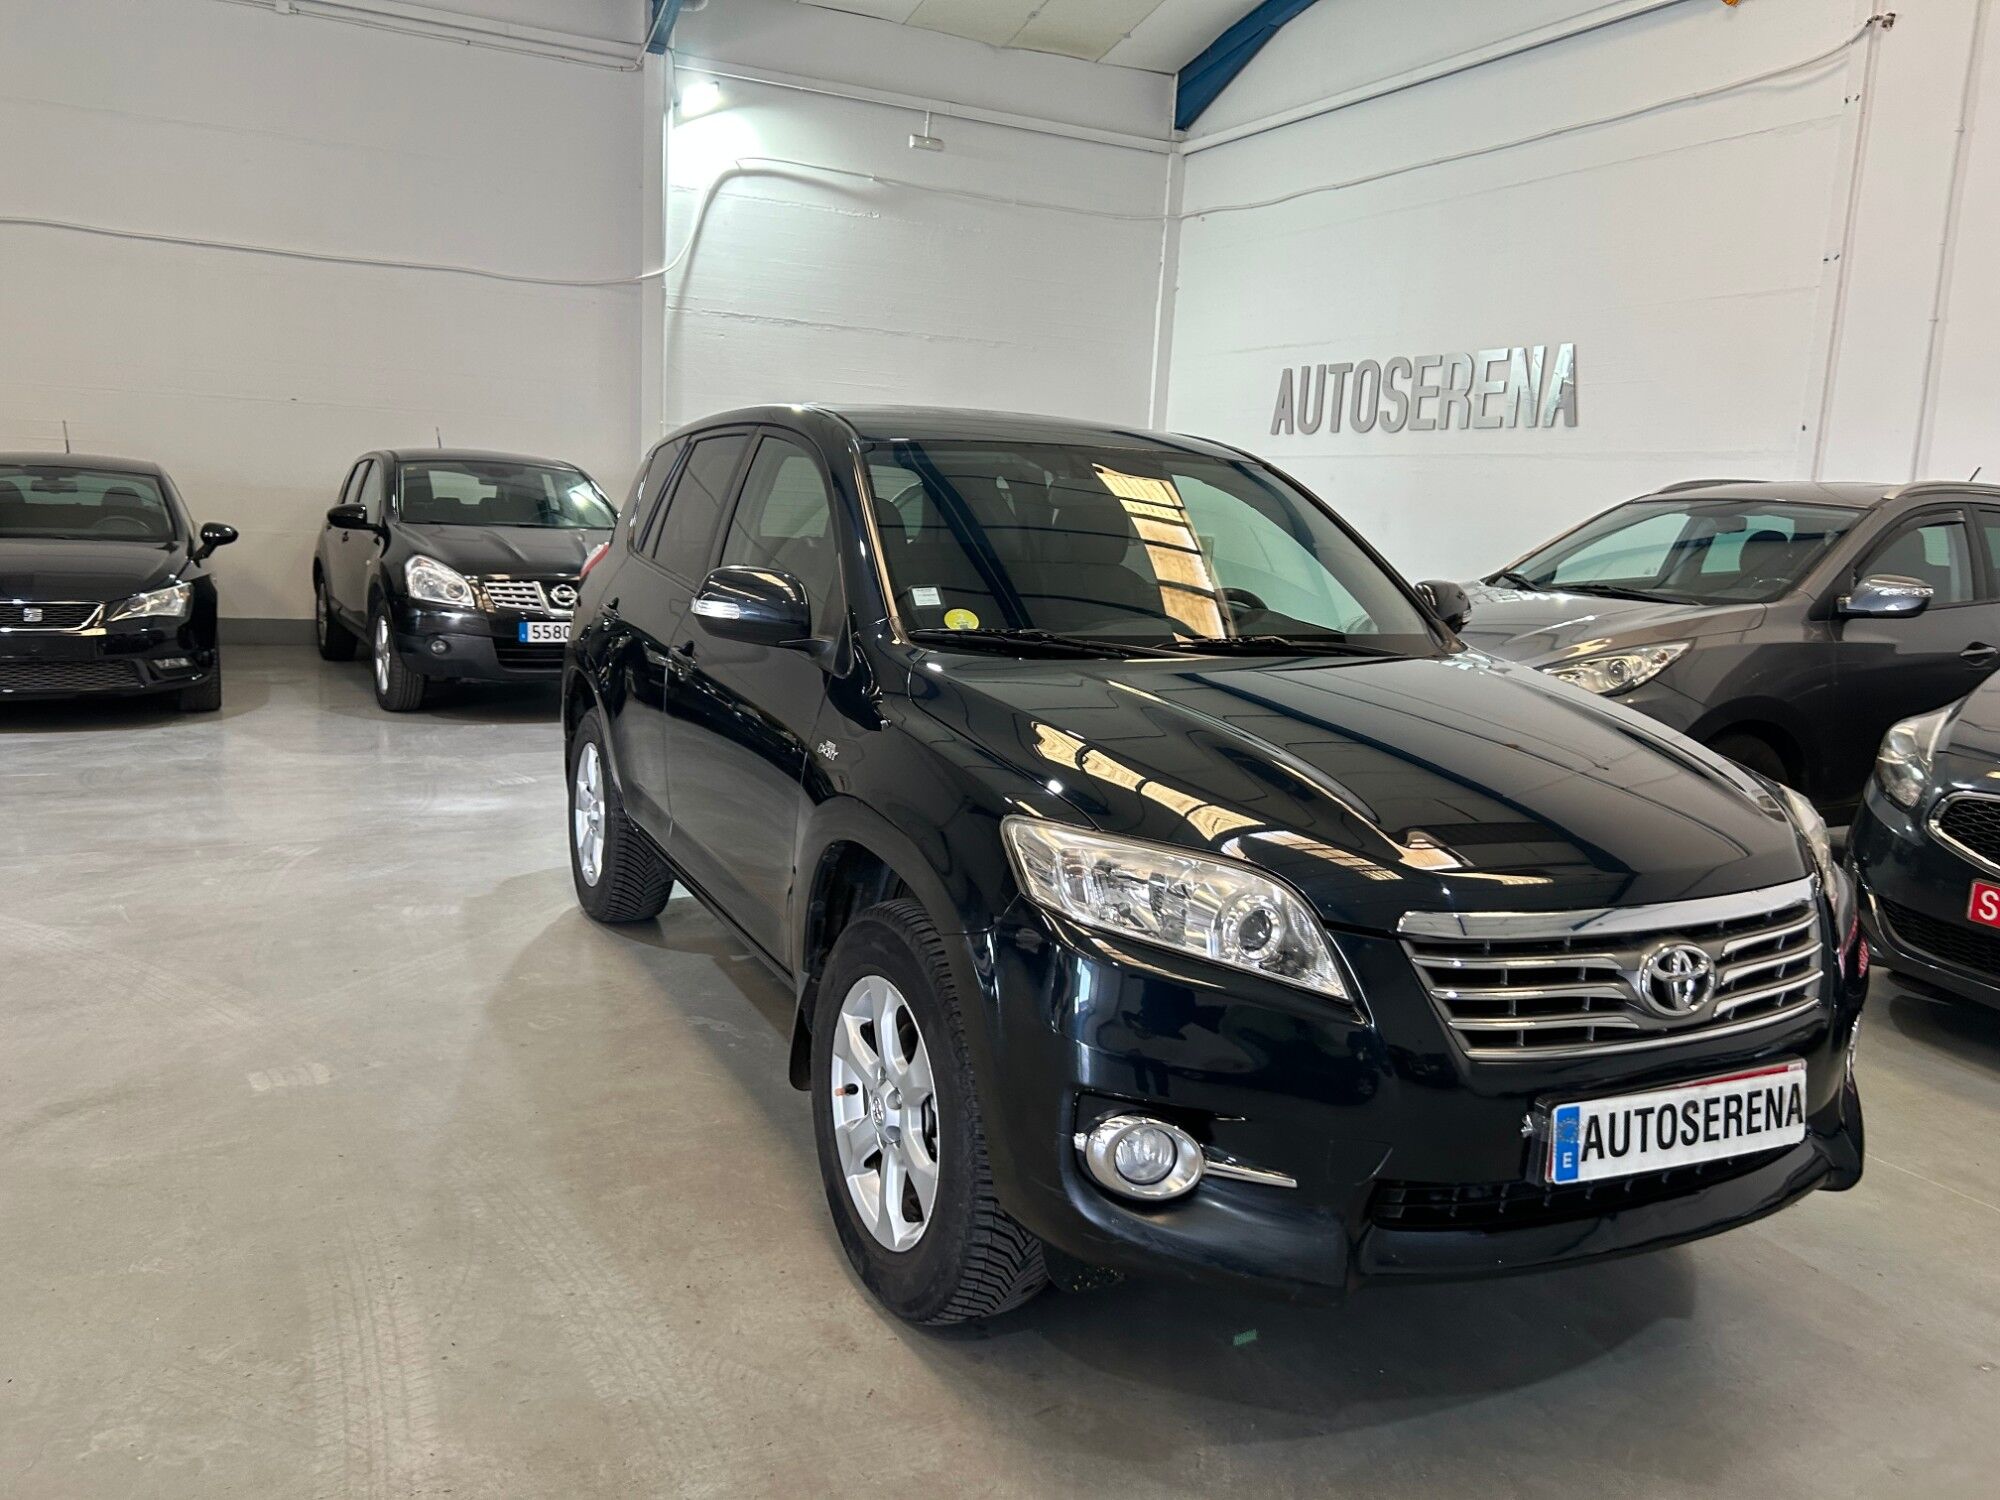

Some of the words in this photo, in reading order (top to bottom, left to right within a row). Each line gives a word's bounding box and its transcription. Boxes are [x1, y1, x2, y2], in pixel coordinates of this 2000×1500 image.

[1270, 342, 1577, 436] AUTOSERENA
[1978, 890, 1999, 921] S
[1581, 1083, 1804, 1162] AUTOSERENA
[1562, 1152, 1573, 1168] E
